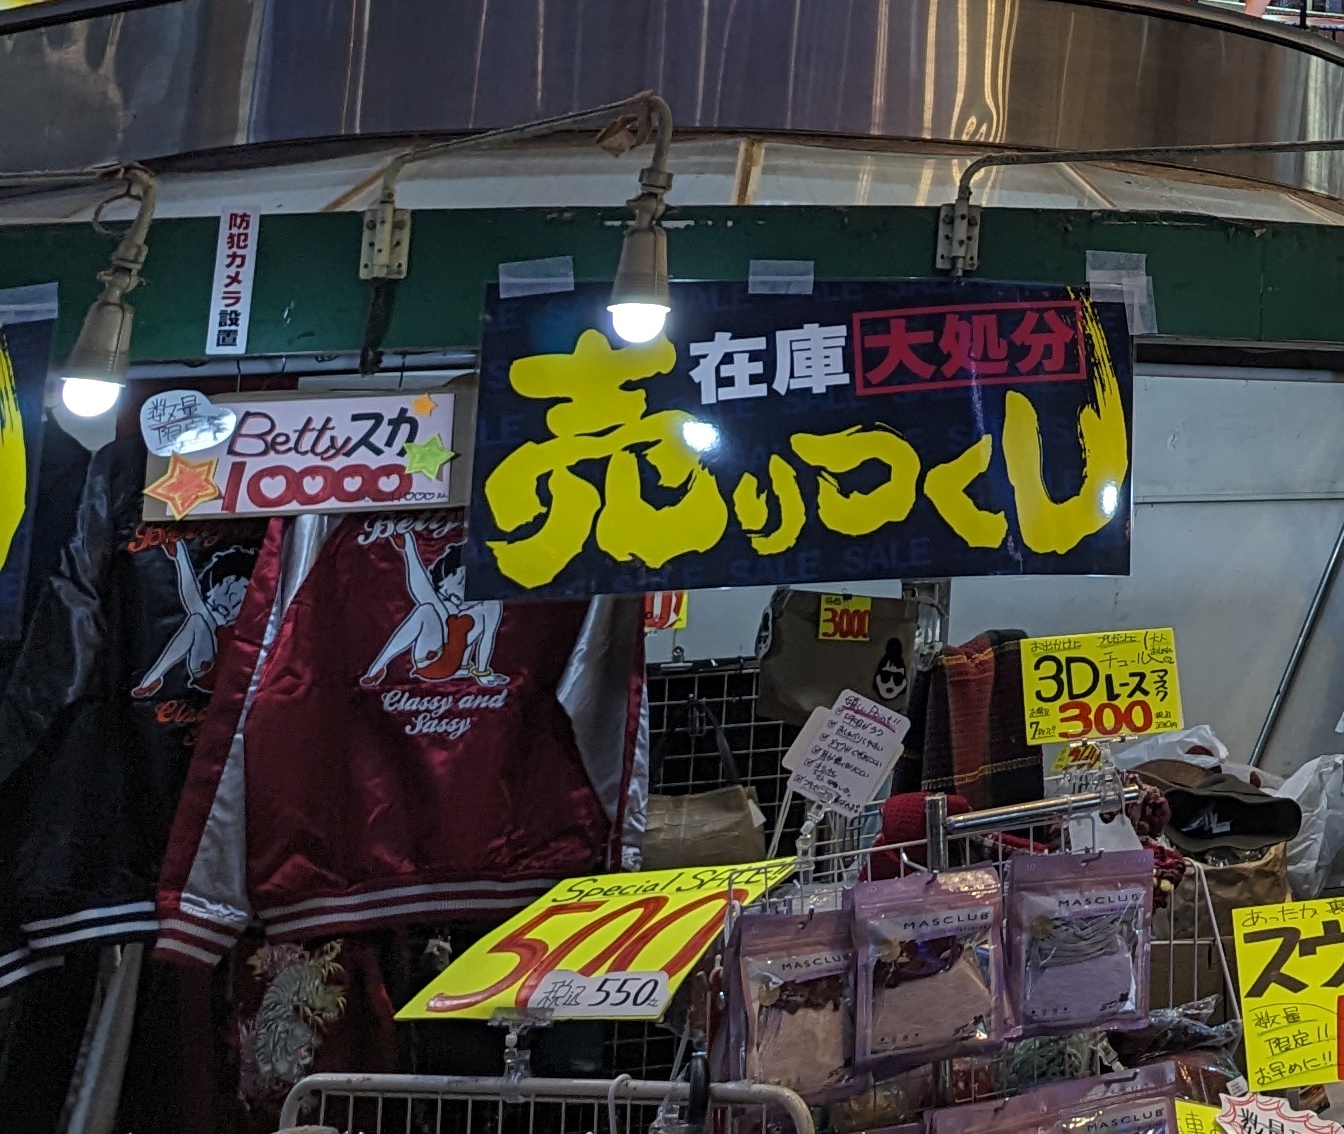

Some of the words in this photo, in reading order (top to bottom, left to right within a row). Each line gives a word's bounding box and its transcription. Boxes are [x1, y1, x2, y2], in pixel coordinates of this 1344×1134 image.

[216, 211, 252, 348] 防犯カメラ設置
[690, 322, 851, 404] 在庫
[862, 309, 1075, 384] 大処分
[484, 287, 1128, 590] 売りつくし
[221, 461, 413, 515] 10000
[822, 606, 871, 638] 3000
[382, 690, 455, 719] Classy
[458, 688, 507, 710] and
[1058, 699, 1154, 739] 300
[404, 713, 474, 741] Sassy
[551, 873, 679, 904] Special
[1057, 892, 1143, 909] MASCLUB
[903, 911, 990, 931] MASCLUB
[1242, 902, 1320, 928] あったか
[426, 887, 750, 1015] 500
[1086, 1108, 1165, 1133] MASCLUB
